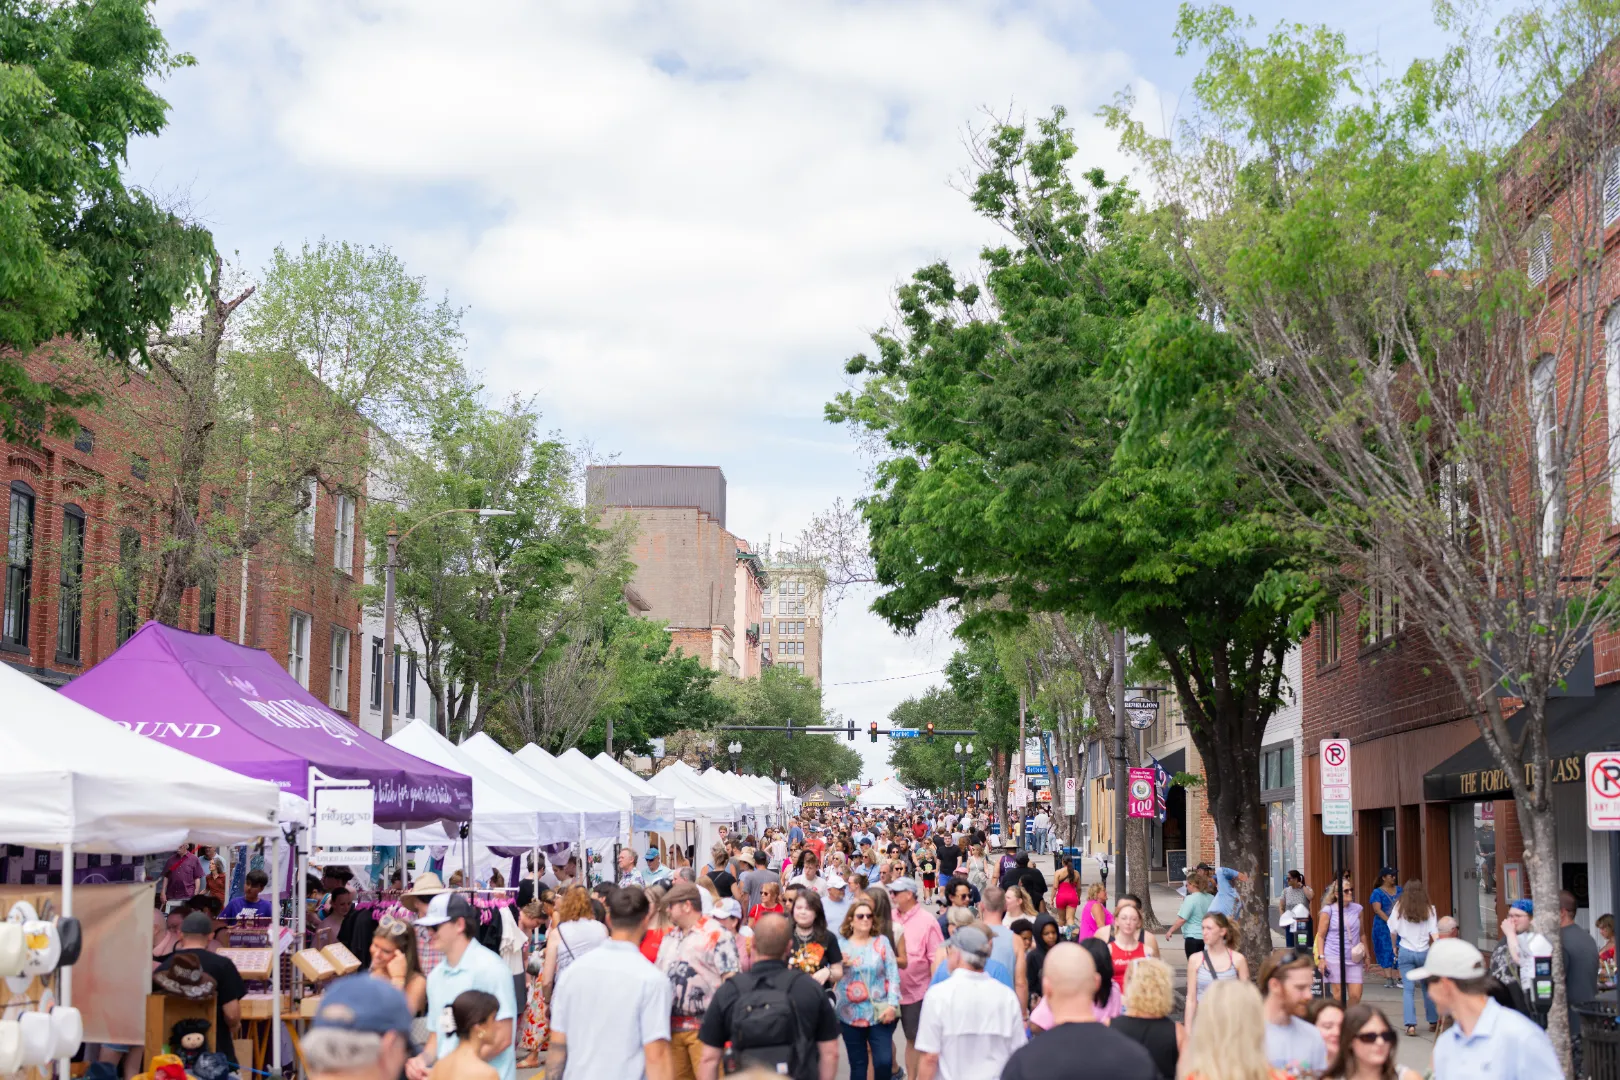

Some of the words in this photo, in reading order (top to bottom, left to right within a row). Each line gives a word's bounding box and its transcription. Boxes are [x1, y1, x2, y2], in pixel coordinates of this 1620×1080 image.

[1460, 772, 1477, 794] THE
[1131, 799, 1152, 814] 100
[1594, 803, 1608, 812] ANY
[321, 812, 371, 821] PROFOUND
